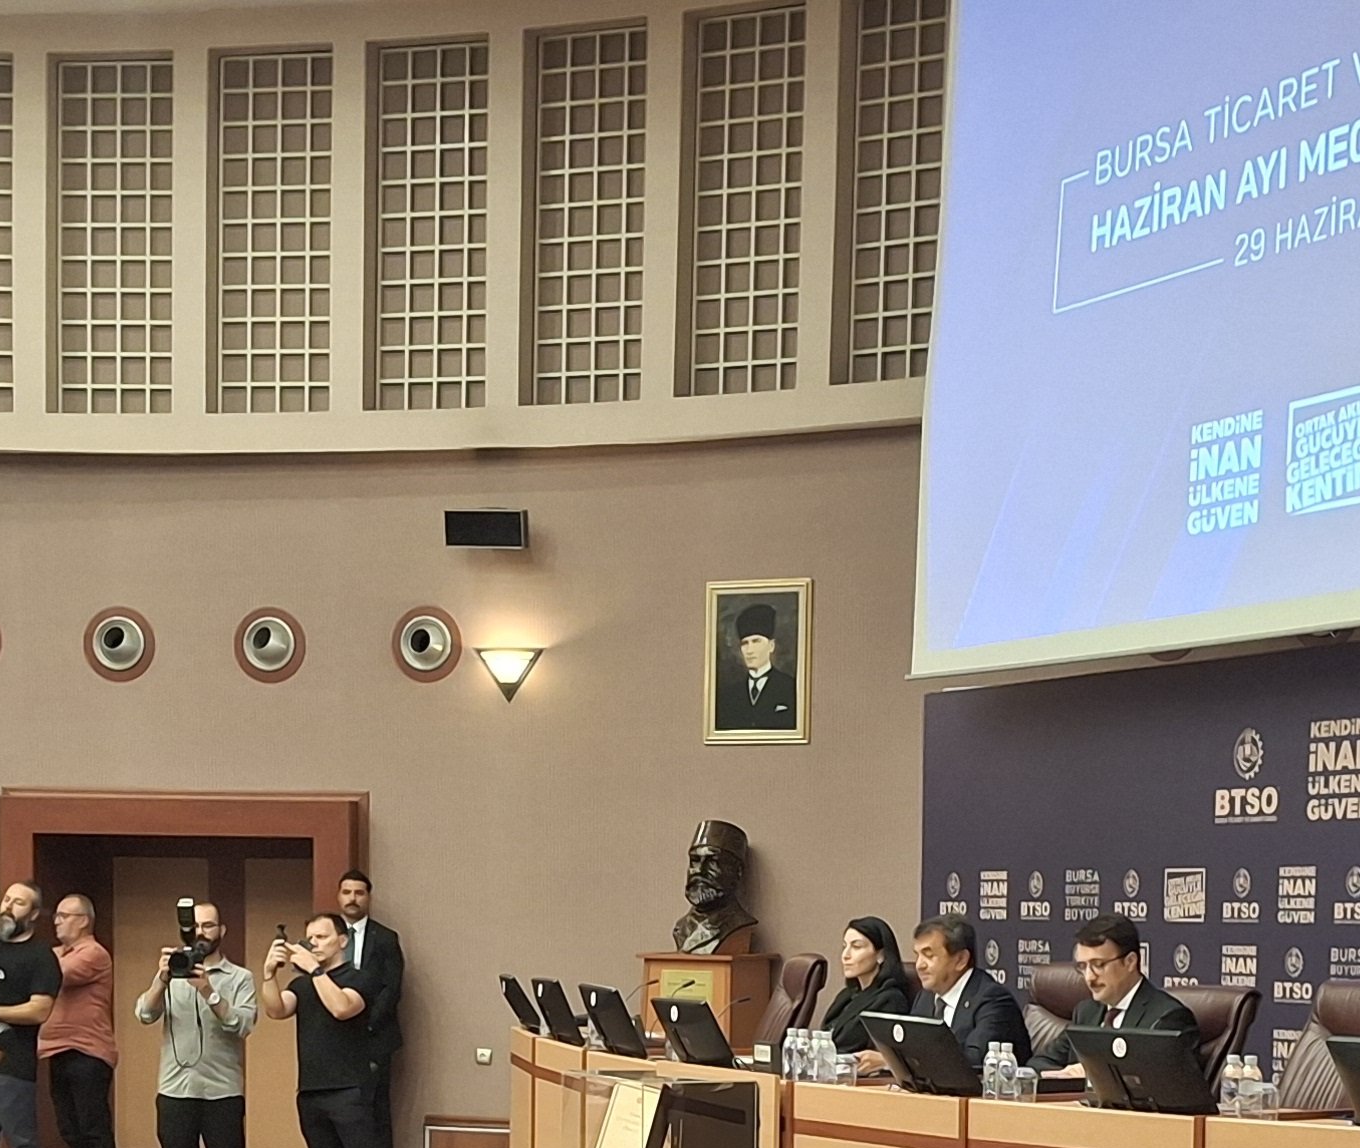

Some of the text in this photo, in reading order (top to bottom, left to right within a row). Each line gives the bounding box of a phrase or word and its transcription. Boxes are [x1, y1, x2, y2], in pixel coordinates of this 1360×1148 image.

[1095, 118, 1193, 186] BURSA
[1204, 57, 1341, 145] TİCARET
[1090, 173, 1227, 253] HAZİRAN
[1236, 147, 1288, 205] AYI
[1234, 230, 1267, 266] 29
[1214, 785, 1279, 817] BTSO
[1065, 868, 1100, 883] BURSA
[1020, 901, 1050, 917] BTSO
[1222, 902, 1259, 919] BTSO
[1273, 981, 1313, 1000] BTSO
